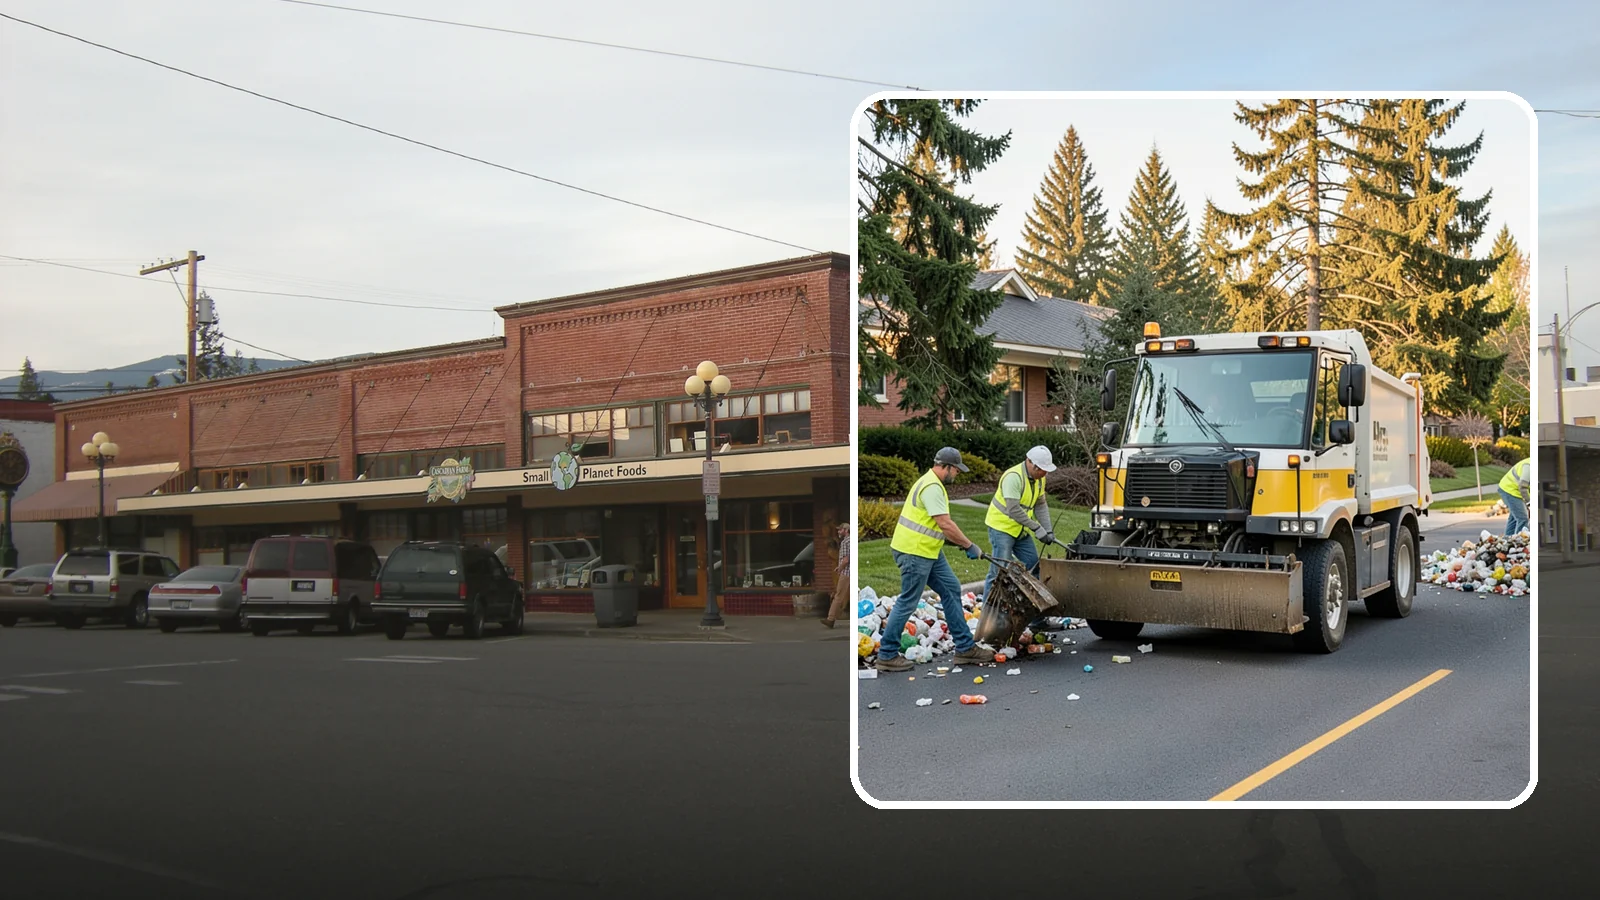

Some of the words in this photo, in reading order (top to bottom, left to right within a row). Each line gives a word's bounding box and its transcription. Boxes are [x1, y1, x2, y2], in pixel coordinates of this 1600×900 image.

[523, 471, 549, 482] Small
[583, 468, 614, 479] Planet
[617, 464, 647, 477] Foods
